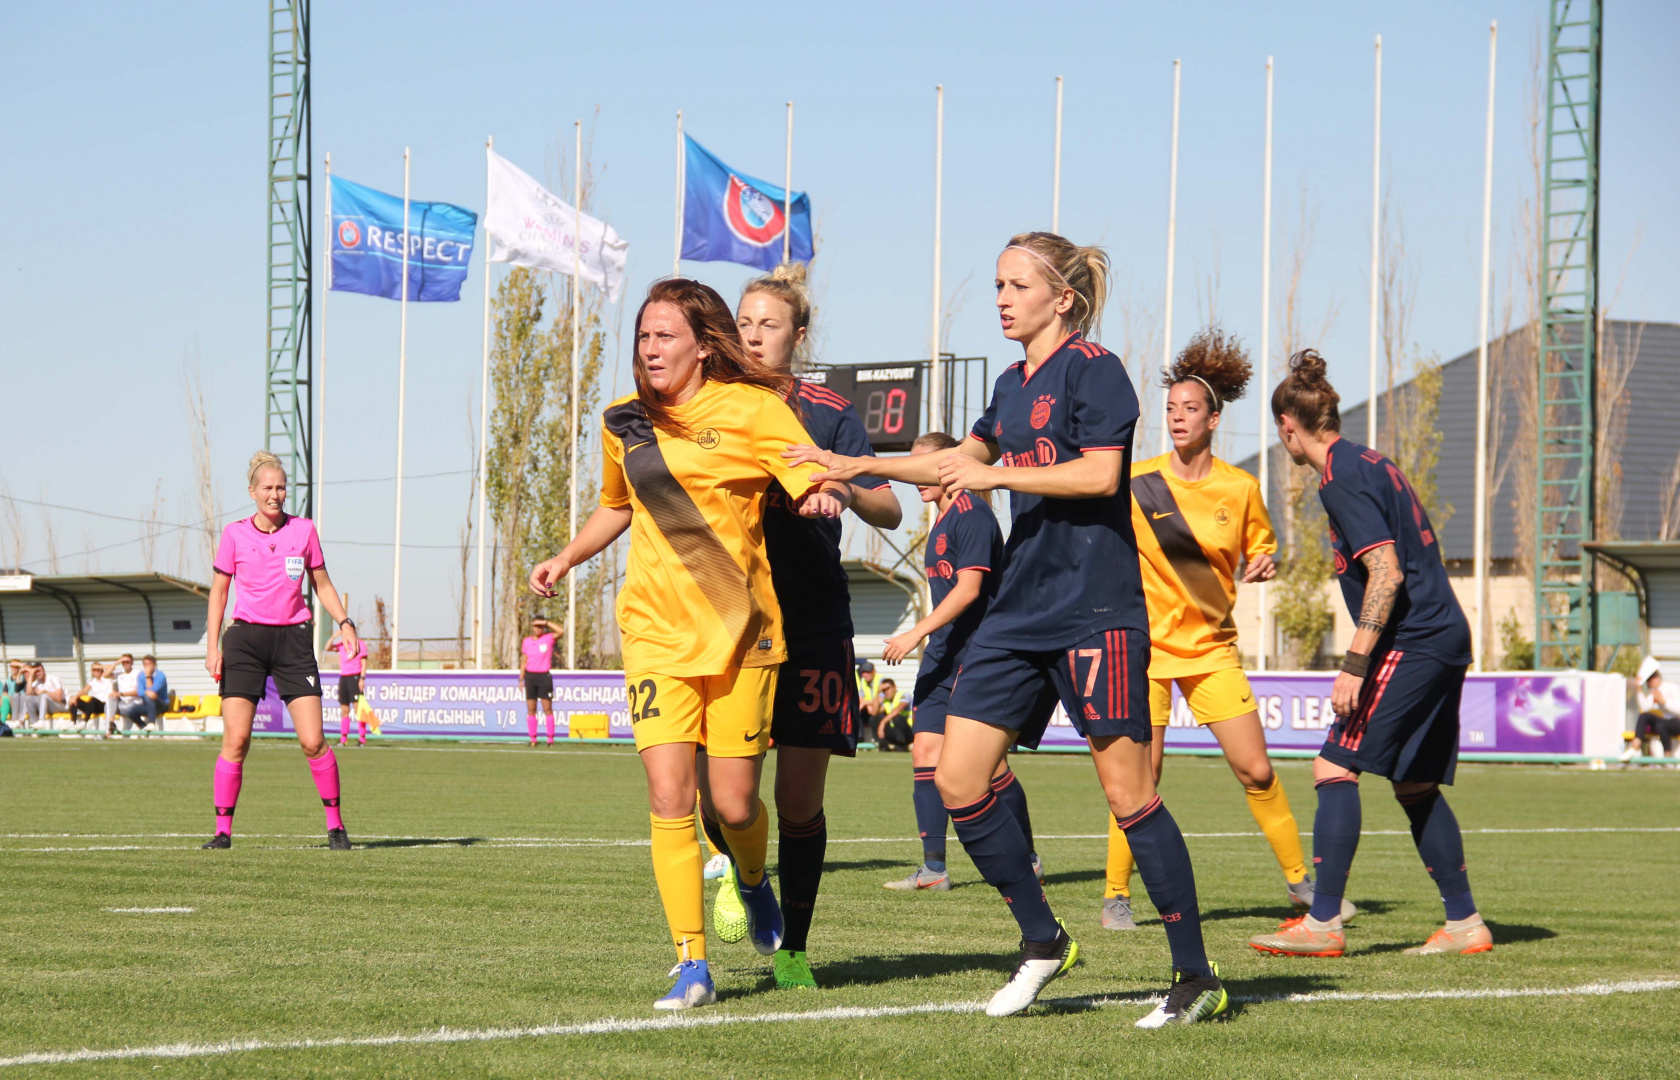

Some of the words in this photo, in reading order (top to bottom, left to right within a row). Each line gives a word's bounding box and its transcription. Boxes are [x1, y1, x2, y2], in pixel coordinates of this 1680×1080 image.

[366, 224, 471, 263] RESPECT
[798, 669, 843, 714] 30
[1067, 648, 1103, 698] 17
[496, 709, 518, 729] 1/8
[628, 678, 661, 725] 22
[1469, 731, 1485, 743] TM
